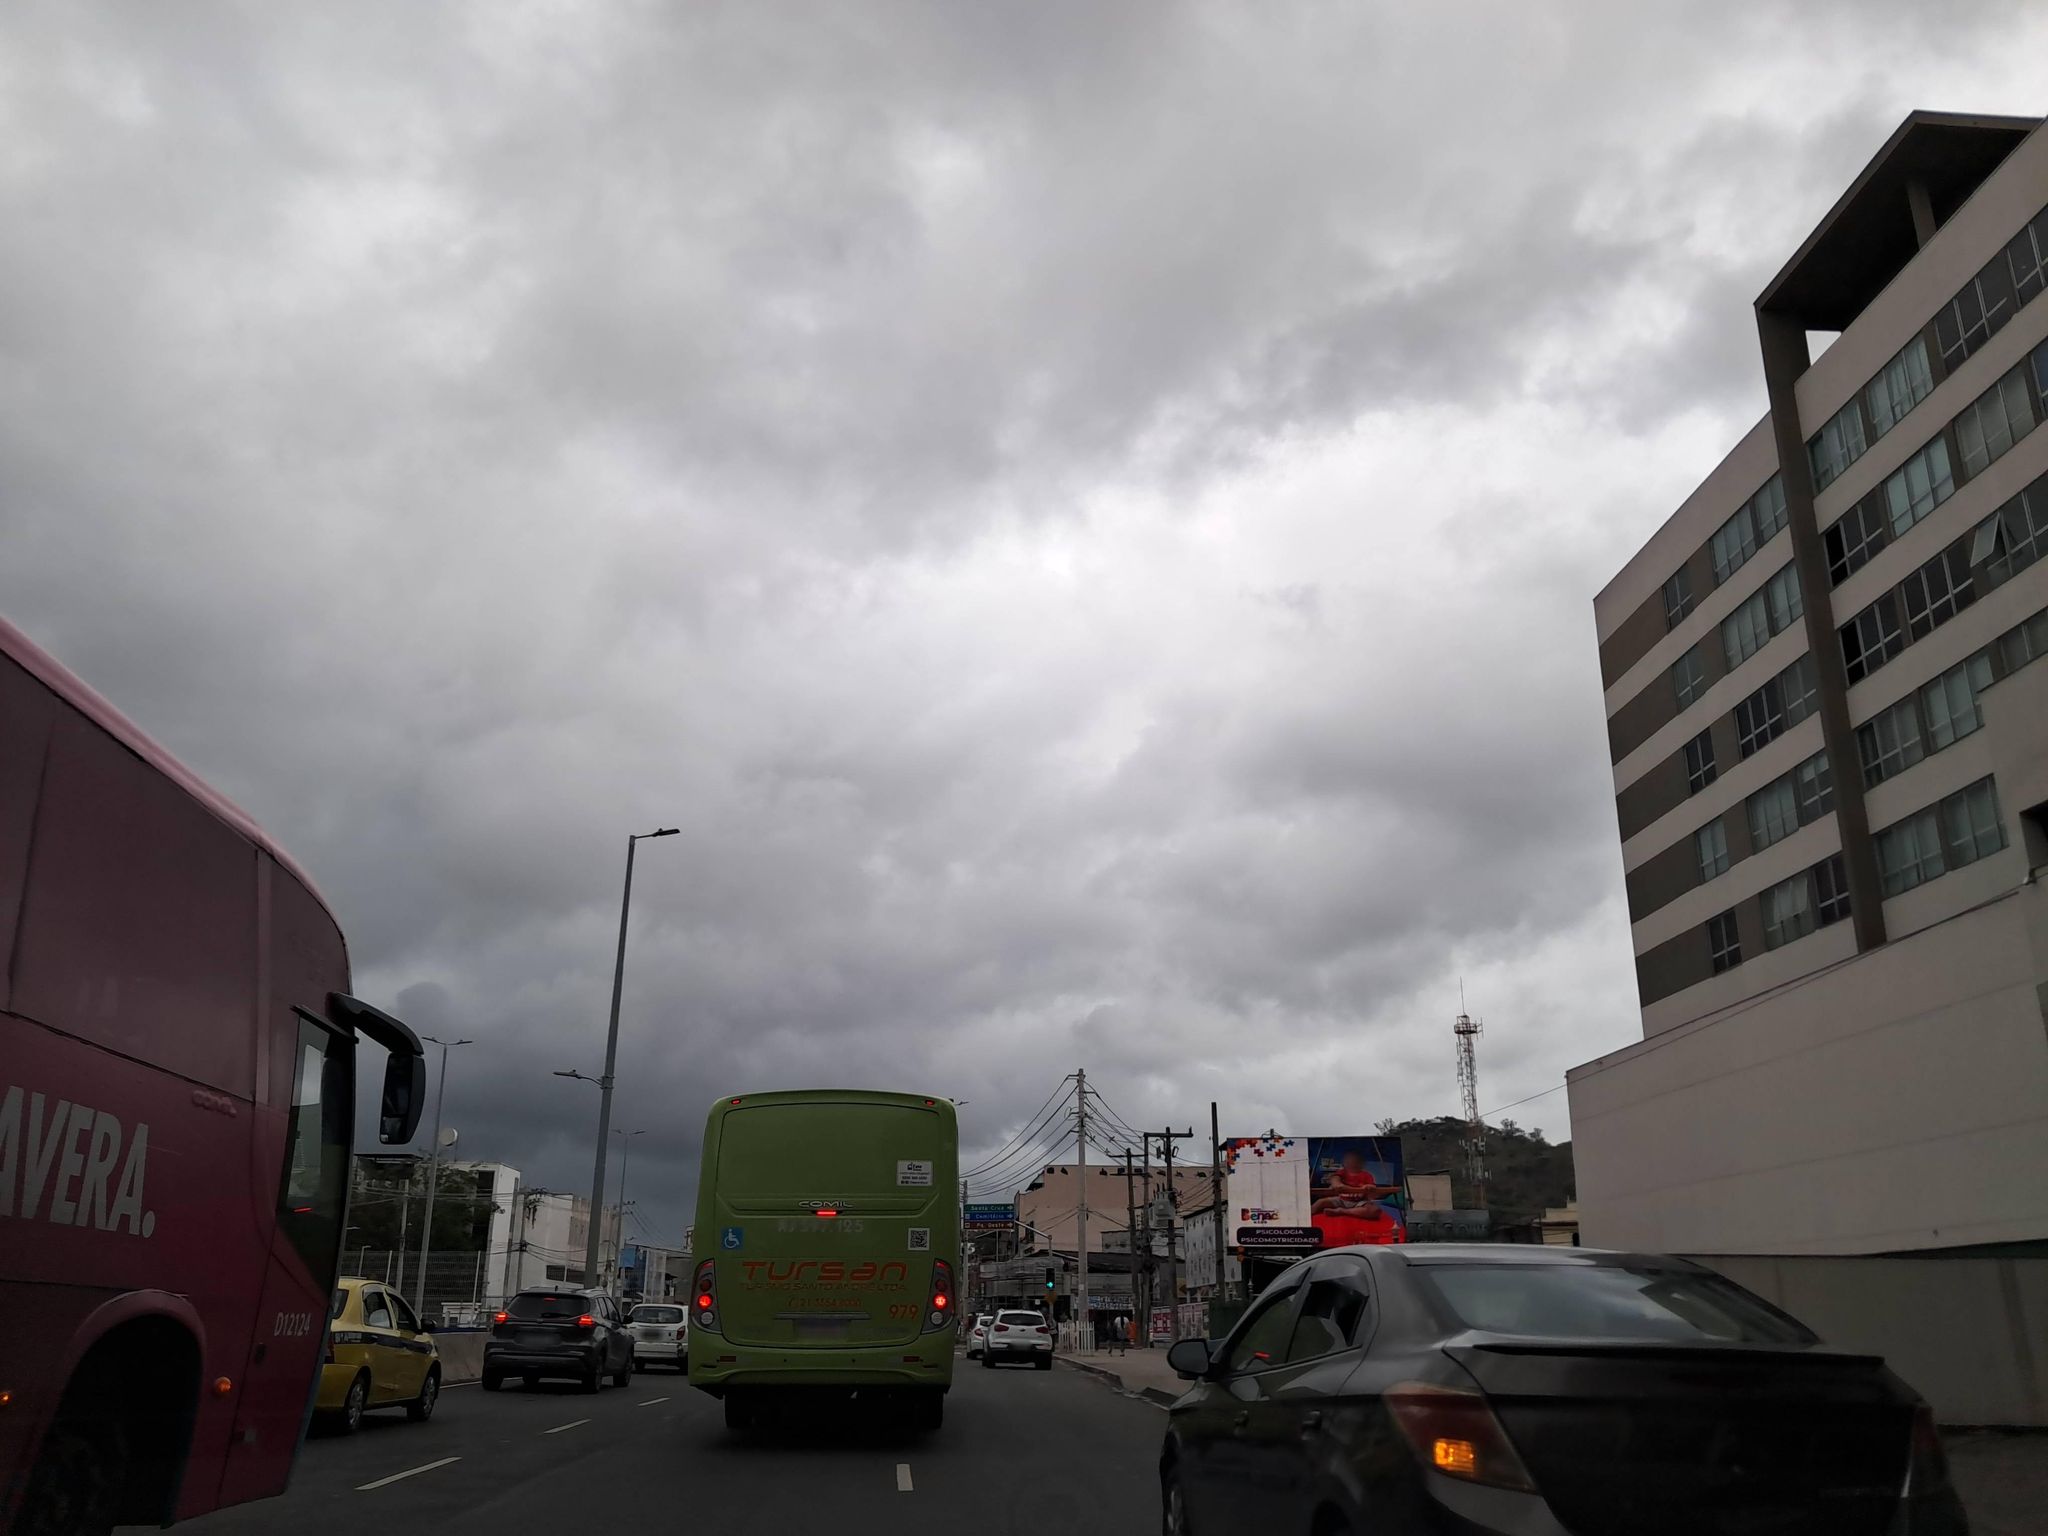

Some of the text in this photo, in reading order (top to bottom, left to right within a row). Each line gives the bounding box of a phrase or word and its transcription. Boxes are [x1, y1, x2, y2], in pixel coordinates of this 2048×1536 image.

[798, 1200, 854, 1208] COMIL
[792, 1282, 834, 1291] SANTO
[888, 1304, 919, 1319] 979
[273, 1311, 312, 1337] D12124
